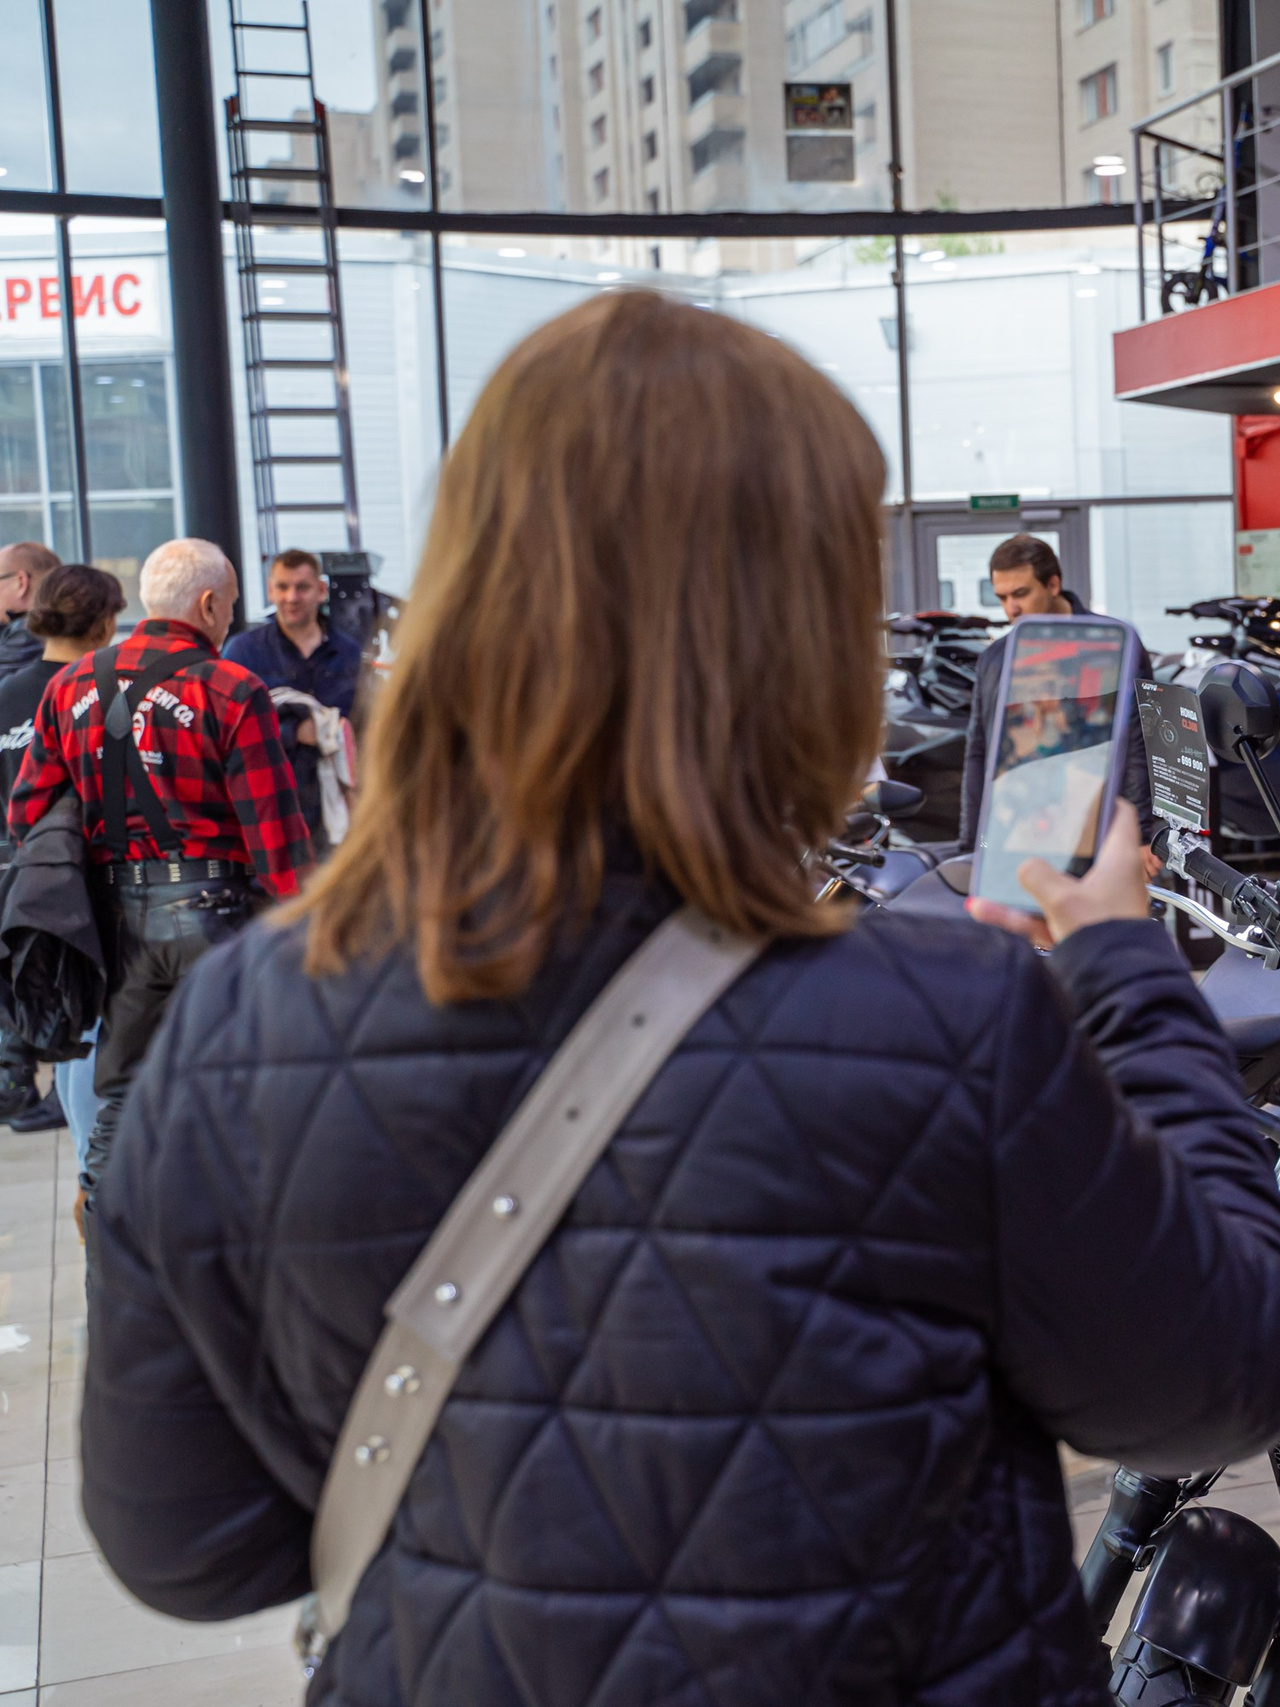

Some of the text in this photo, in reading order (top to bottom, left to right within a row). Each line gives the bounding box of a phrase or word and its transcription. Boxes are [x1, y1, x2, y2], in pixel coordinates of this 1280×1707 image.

[0, 274, 141, 320] РВИС
[173, 704, 195, 728] CO.
[1180, 706, 1198, 722] HONDA
